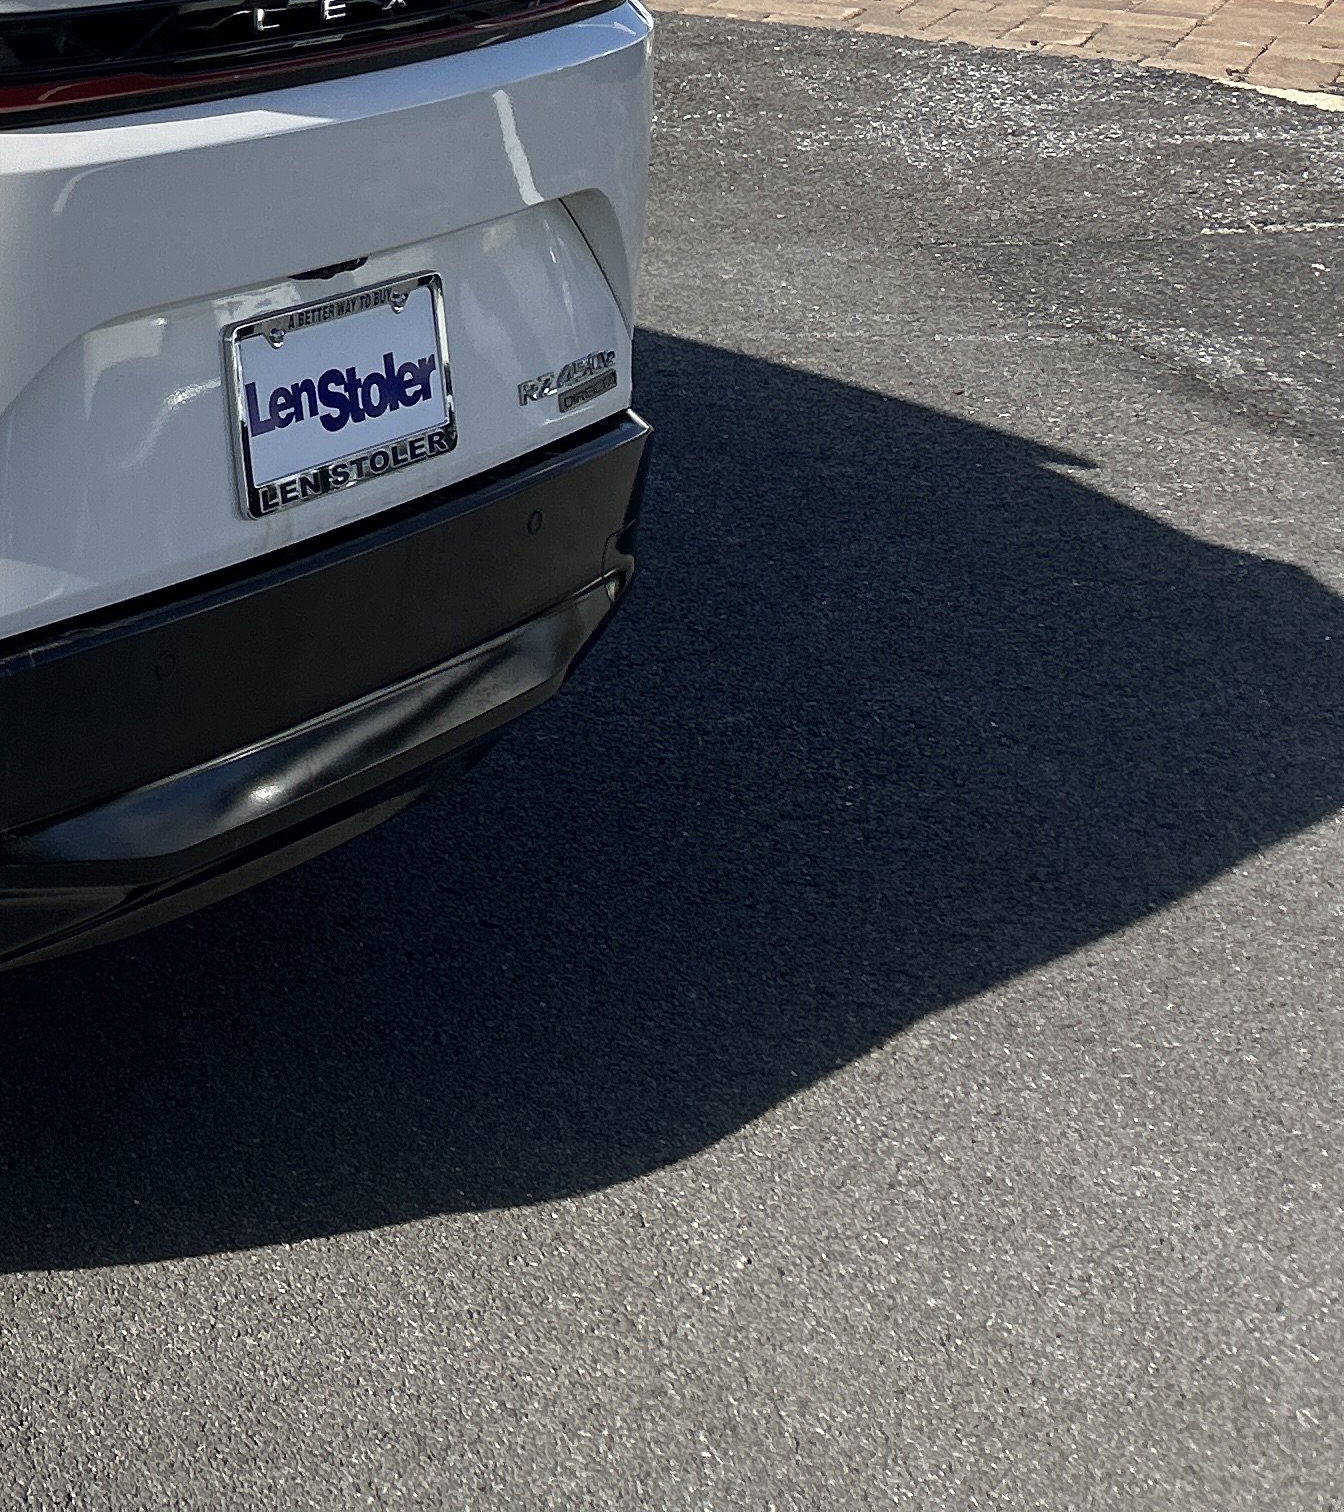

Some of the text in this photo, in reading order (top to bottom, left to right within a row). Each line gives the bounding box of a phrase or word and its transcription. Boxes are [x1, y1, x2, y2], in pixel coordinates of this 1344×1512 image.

[298, 304, 335, 327] BETTER
[336, 299, 357, 320] WAY
[360, 294, 372, 311] TO
[261, 430, 449, 513] LEN STOLER
